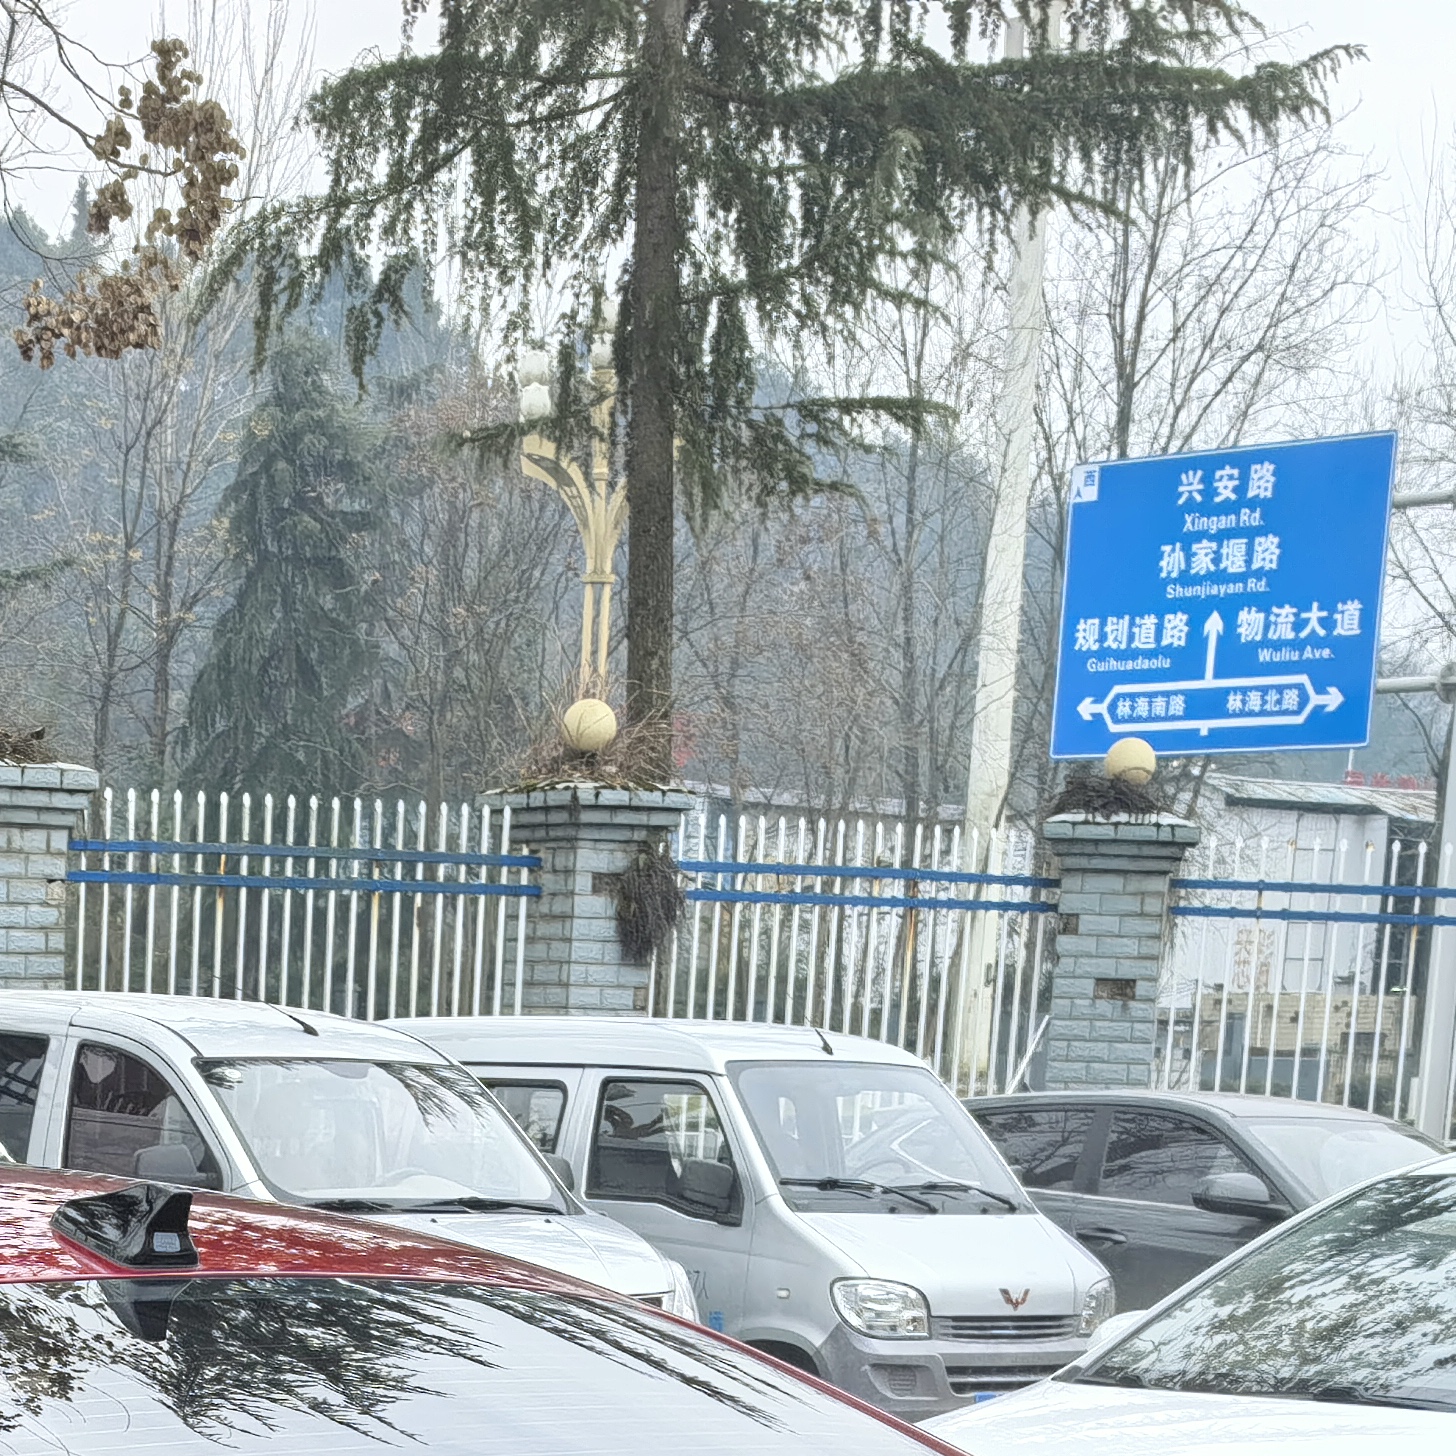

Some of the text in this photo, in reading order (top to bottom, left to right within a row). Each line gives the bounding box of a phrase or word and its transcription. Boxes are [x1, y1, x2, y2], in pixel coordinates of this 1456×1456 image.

[1177, 461, 1277, 505] 兴安路
[1183, 507, 1265, 534] Xingan Rd.
[1159, 533, 1281, 579] 孙家堰路
[1247, 576, 1270, 592] Rd.
[1074, 611, 1189, 651] 规划道路
[1236, 598, 1363, 643] 物流大道
[1087, 654, 1171, 672] Guihuadaolu
[1258, 644, 1335, 663] Wuliu Ave.
[1116, 694, 1186, 719] 林海南路
[1226, 688, 1300, 714] 林海北路
